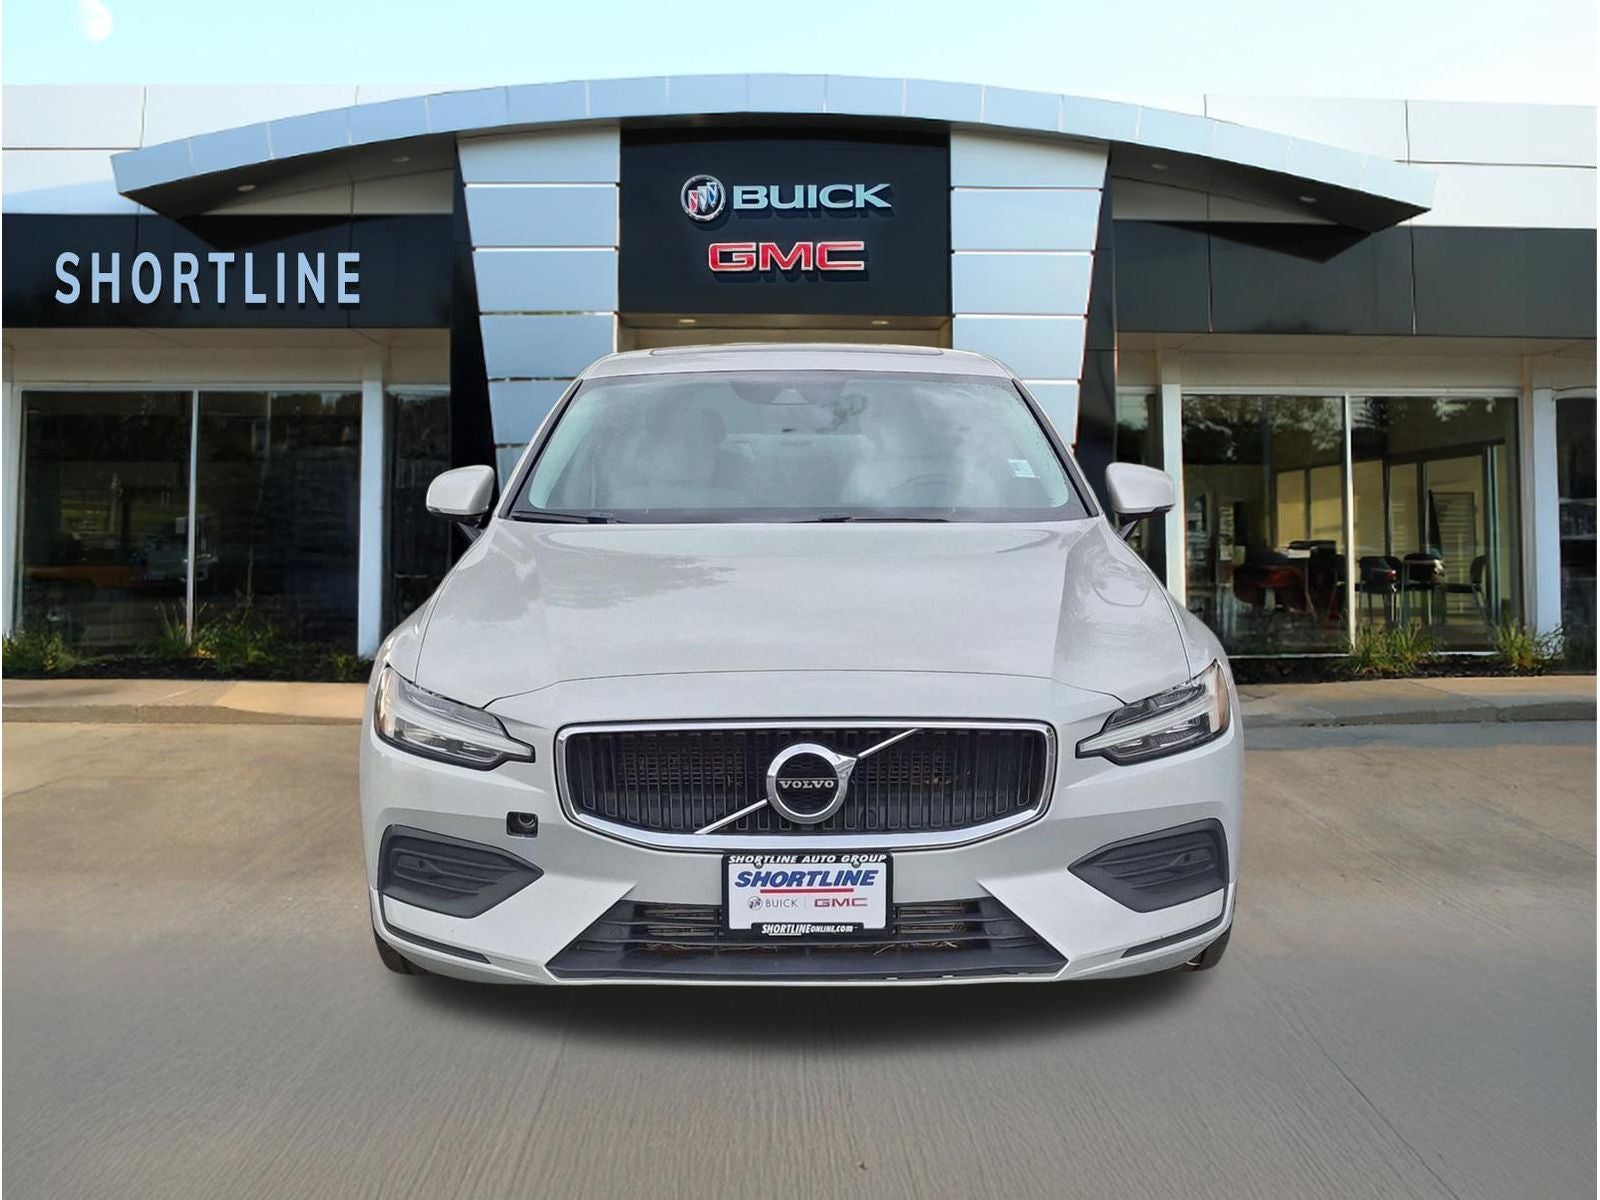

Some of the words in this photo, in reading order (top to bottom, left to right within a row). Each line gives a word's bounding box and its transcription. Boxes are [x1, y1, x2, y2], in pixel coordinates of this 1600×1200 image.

[733, 183, 893, 210] BUICK
[708, 240, 865, 272] GMC
[54, 251, 361, 304] SHORTLINE
[778, 780, 834, 789] VOLVO
[728, 855, 797, 864] SHORTLINE
[801, 855, 836, 863] AUTO
[840, 854, 887, 863] GROUP
[734, 869, 879, 888] SHORTLINE
[765, 897, 799, 908] BUICK
[814, 897, 868, 908] GMC
